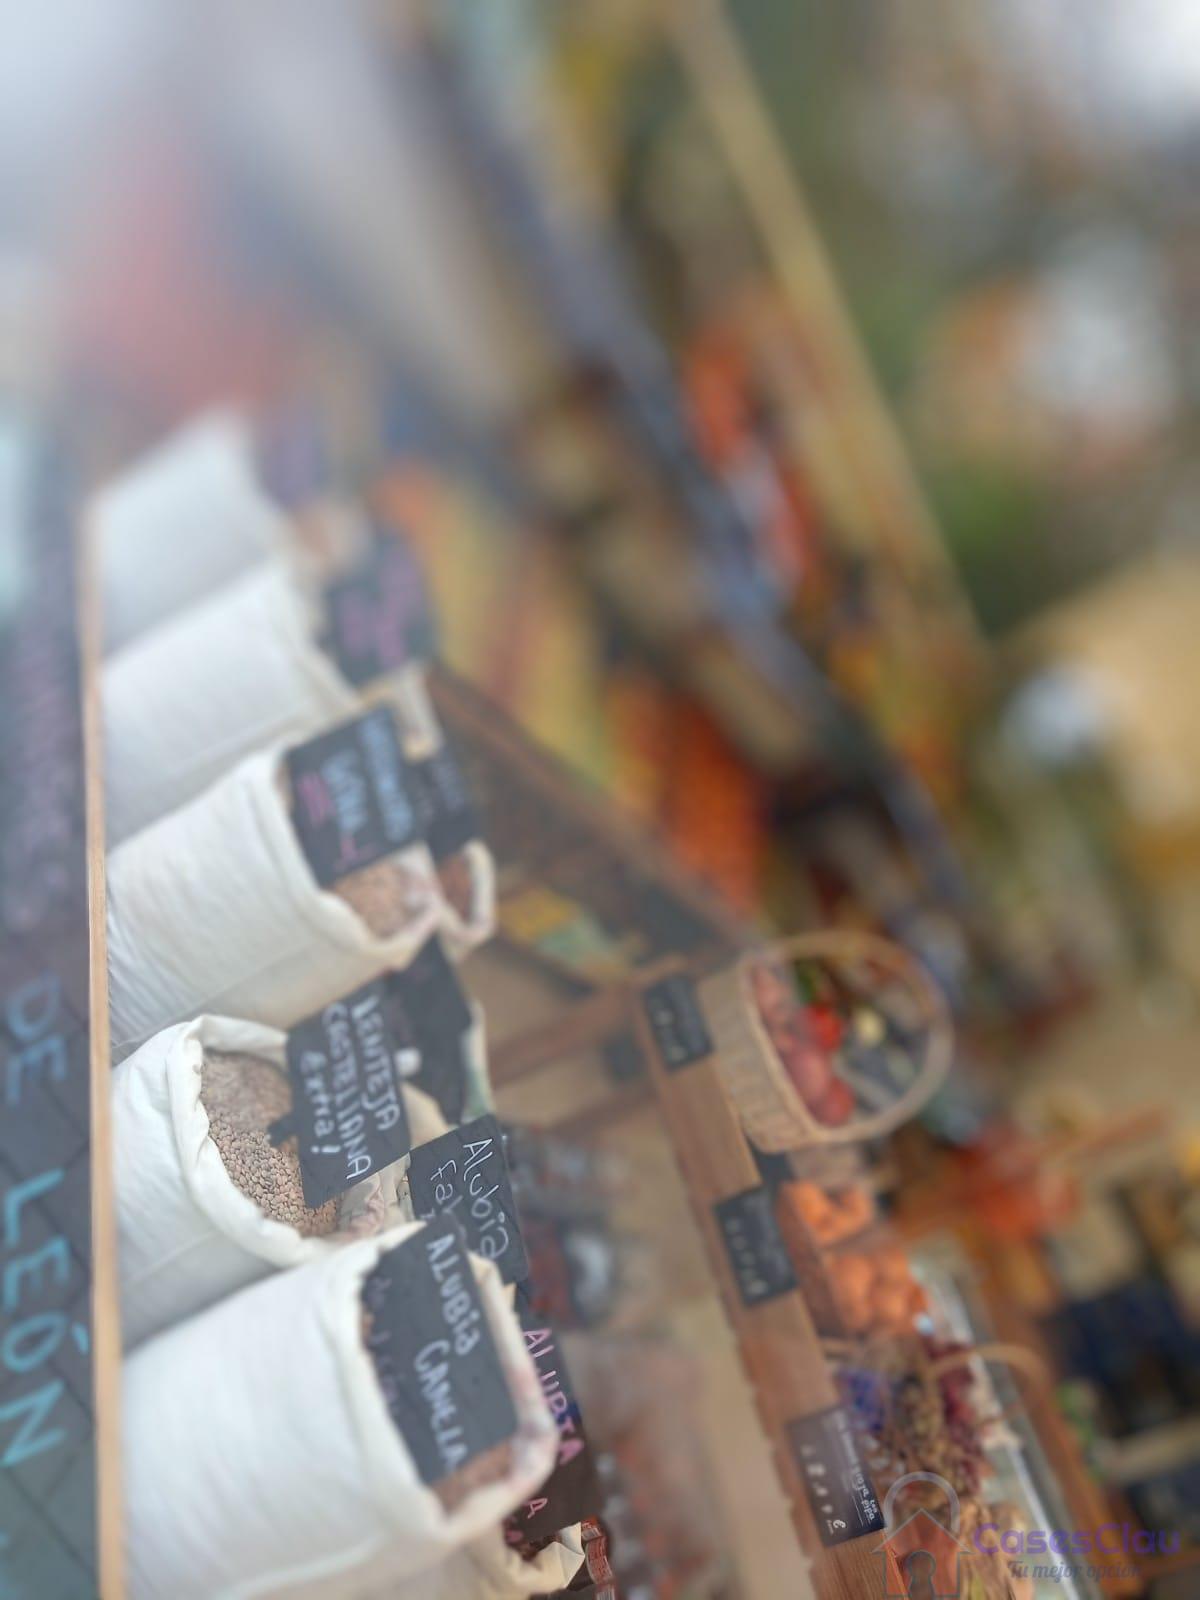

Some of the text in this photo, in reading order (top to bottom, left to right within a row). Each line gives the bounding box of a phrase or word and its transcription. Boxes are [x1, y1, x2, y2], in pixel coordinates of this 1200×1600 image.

[6, 971, 67, 1108] DE
[462, 1138, 509, 1260] Alubia
[0, 1168, 89, 1468] LEÓN
